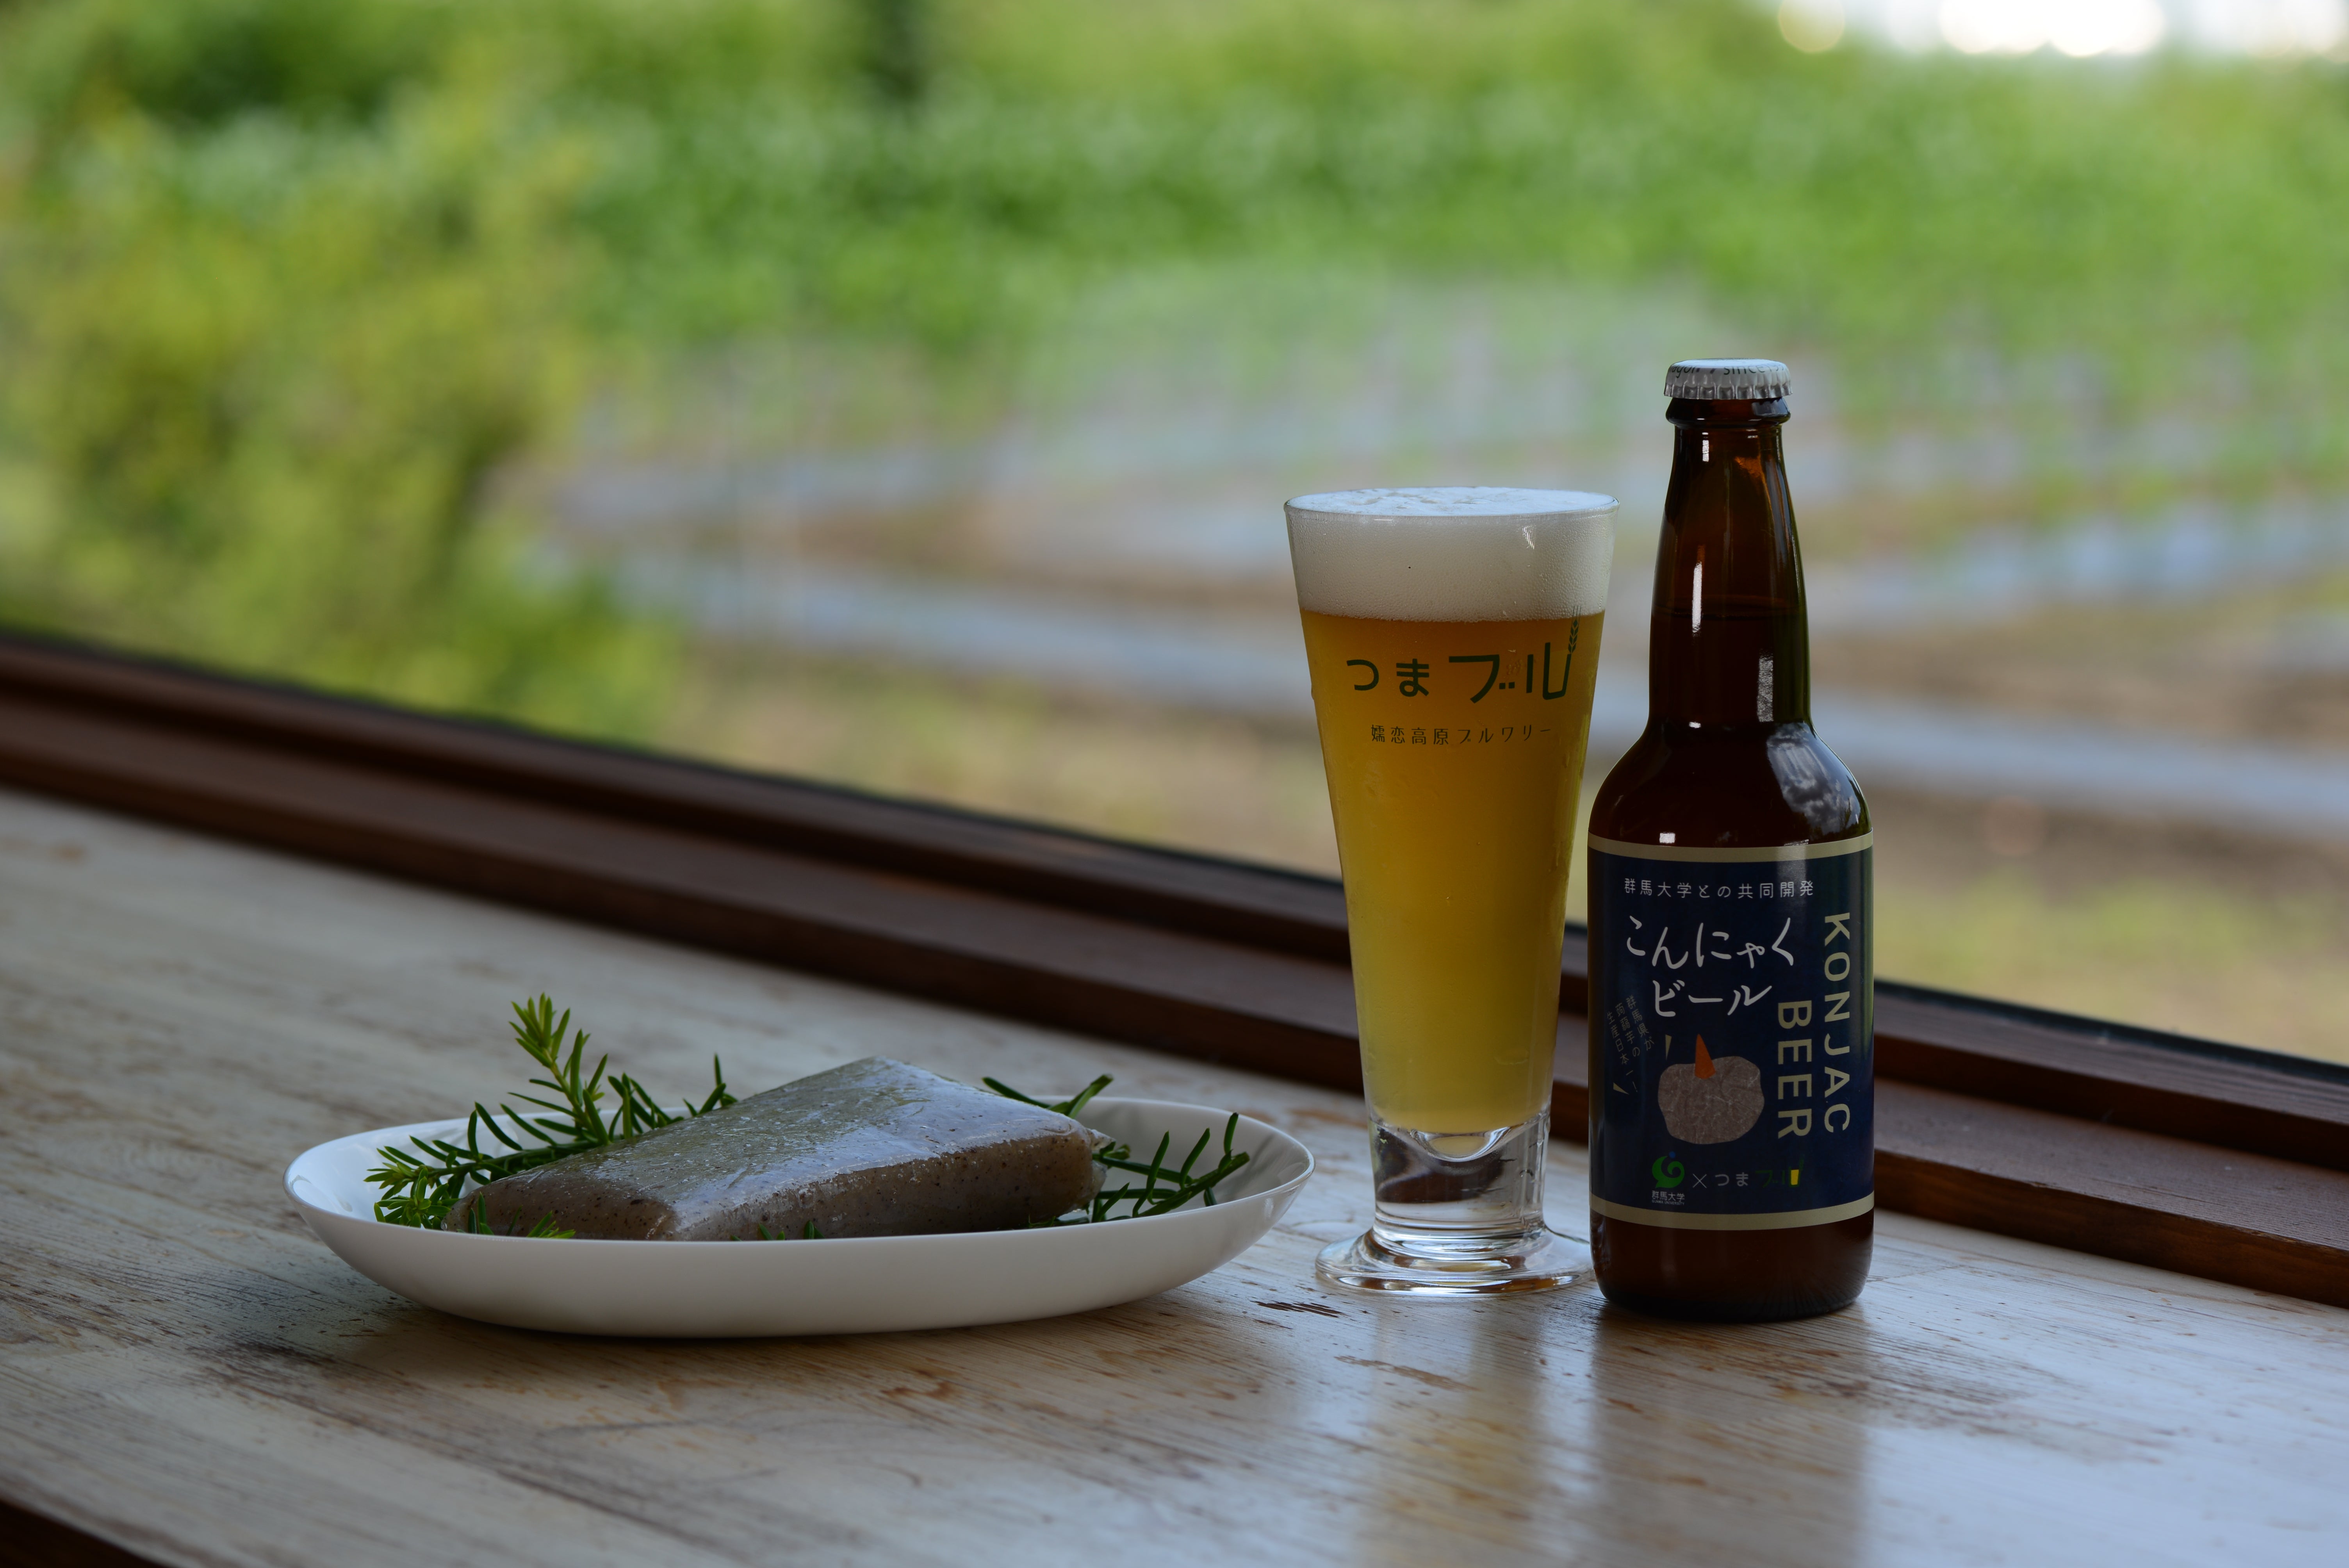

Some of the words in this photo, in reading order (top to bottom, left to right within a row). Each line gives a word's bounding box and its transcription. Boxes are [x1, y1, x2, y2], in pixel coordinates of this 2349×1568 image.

[1346, 642, 1572, 703] つまブル
[1371, 724, 1552, 745] 嬬恋高原ブルワリー
[1624, 878, 1814, 900] 群馬大学との共同開発
[1626, 915, 1795, 969] こんにゃく
[1625, 994, 1655, 1051] 群馬県が
[1652, 980, 1772, 1017] ビール
[1824, 912, 1850, 1133] KONJAC
[1777, 1000, 1812, 1139] BEER
[1652, 1190, 1685, 1202] 群馬大学
